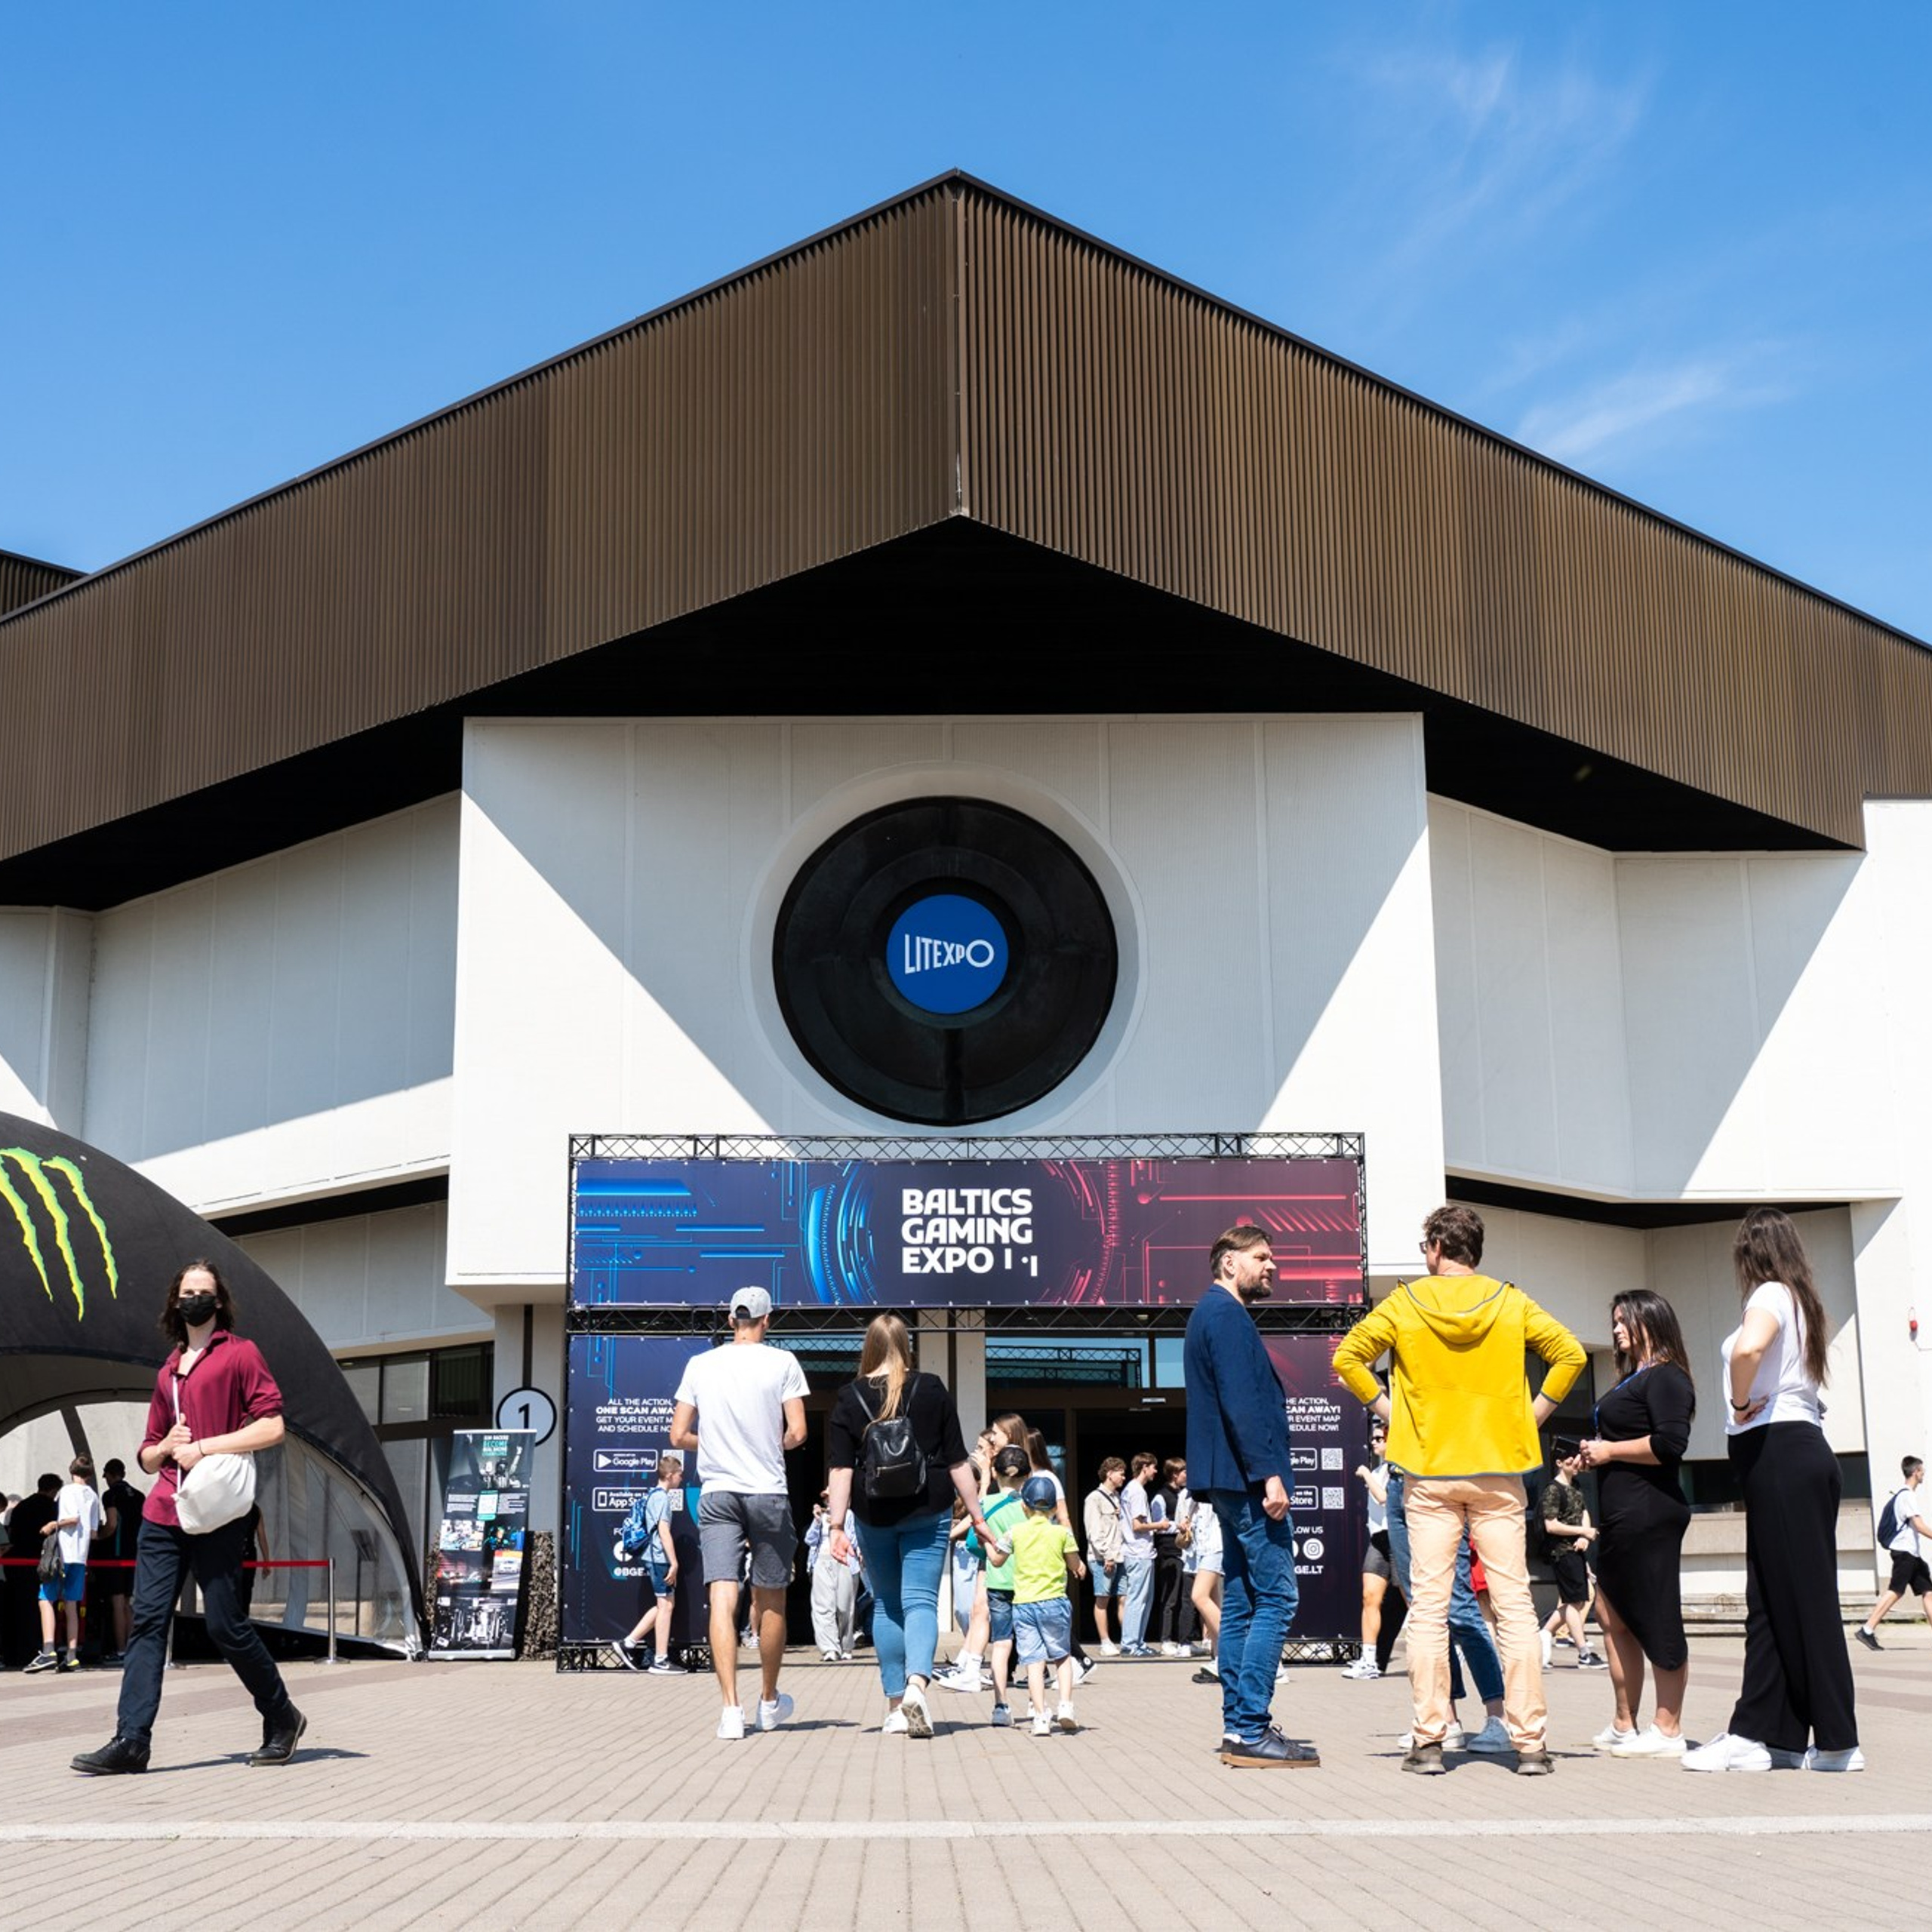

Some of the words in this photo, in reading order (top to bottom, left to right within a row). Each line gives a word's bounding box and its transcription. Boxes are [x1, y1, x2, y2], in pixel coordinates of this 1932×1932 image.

[904, 934, 995, 974] LITEXPO
[901, 1188, 1033, 1215] BALTICS
[901, 1217, 1033, 1244] GAMING
[901, 1246, 995, 1274] EXPO
[1286, 1397, 1297, 1405] HE
[595, 1406, 618, 1414] ONE
[620, 1406, 649, 1414] SCAN
[1307, 1405, 1341, 1414] AWAY!
[518, 1403, 530, 1429] 1
[1295, 1414, 1321, 1423] EVENT
[617, 1425, 659, 1433] SCHEDULE
[1318, 1423, 1340, 1432] NOW!
[613, 1457, 639, 1467] Google
[641, 1457, 656, 1467] Play
[1300, 1456, 1315, 1466] Play
[609, 1497, 628, 1508] App
[1290, 1495, 1313, 1505] Store
[1311, 1526, 1324, 1534] US
